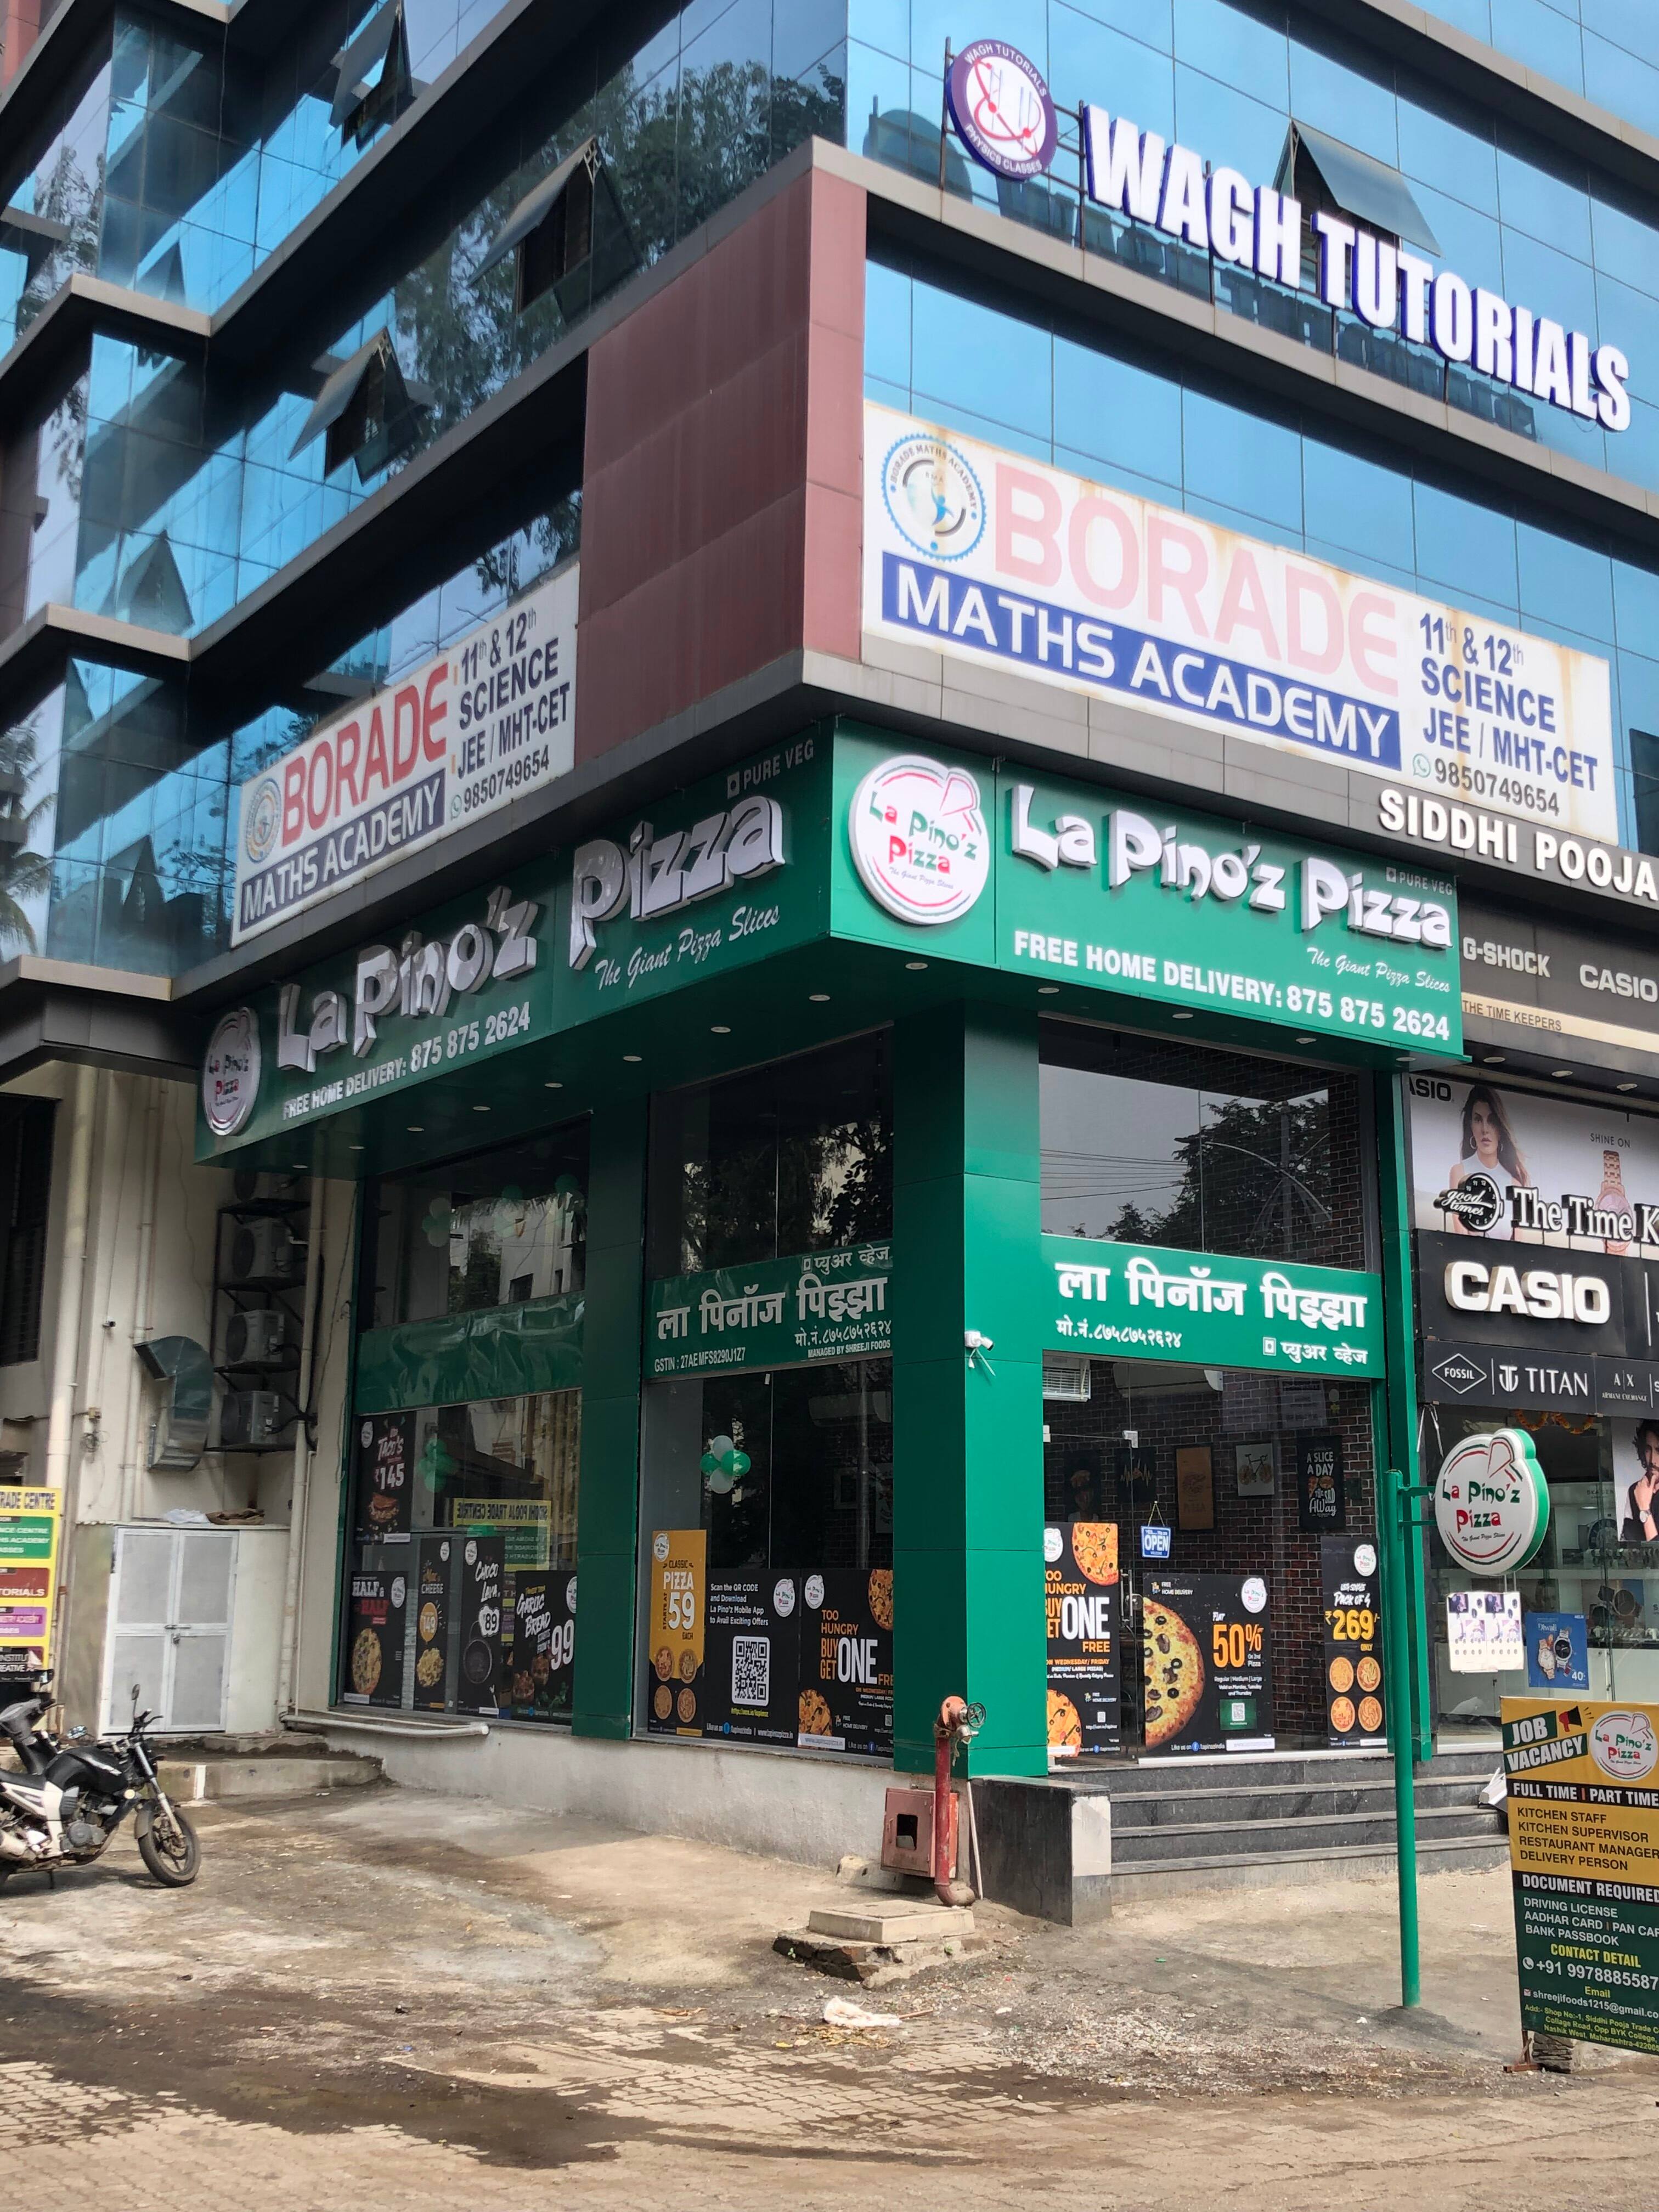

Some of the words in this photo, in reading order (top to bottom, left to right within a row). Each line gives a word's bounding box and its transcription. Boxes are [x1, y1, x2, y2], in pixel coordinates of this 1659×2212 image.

[964, 44, 993, 64] WAGH
[996, 44, 1047, 97] TUTORIALS
[966, 124, 1001, 165] PHYSICS
[1003, 160, 1042, 173] CLASSES
[1081, 104, 1301, 289] WAGH
[1311, 212, 1630, 432] TUTORIALS
[890, 447, 913, 483] BORADE
[949, 458, 977, 509] ACADEMY
[995, 462, 1398, 697] BORADE
[460, 639, 488, 685] 11th
[491, 630, 502, 664] &
[506, 608, 537, 659] 12th
[898, 563, 1115, 679] MATHS
[1130, 641, 1390, 759] ACADEMY
[1420, 613, 1457, 654] 11th
[1463, 627, 1479, 666] &
[1484, 635, 1524, 677] 12th
[459, 637, 559, 730] SCIENCE
[1421, 657, 1556, 733] SCIENCE
[457, 730, 486, 780] JEE
[498, 682, 570, 757] MHT-CET
[1423, 707, 1471, 754] JEE
[1492, 726, 1598, 792] MHT-CET
[281, 662, 449, 848] BORADE
[743, 754, 780, 790] PURE
[785, 738, 814, 769] VEG
[464, 744, 550, 813] 9850749654
[1434, 758, 1560, 816] 9850749654
[869, 791, 898, 825] La
[909, 809, 978, 861] Pino'z
[244, 854, 319, 924] MATHS
[323, 777, 442, 880] ACADEMY
[888, 835, 950, 874] Pizza
[1379, 788, 1518, 864] SIDDHI
[1536, 832, 1659, 903] POOJA
[1012, 784, 1098, 871] La
[1108, 809, 1286, 913] Pino'z
[1301, 857, 1453, 950] Pizza
[1400, 872, 1429, 891] PURE
[1431, 878, 1453, 896] VEG
[278, 983, 348, 1073] La
[353, 885, 539, 1058] Pino'z
[569, 795, 786, 970] Pizza
[595, 959, 621, 990] The
[627, 942, 673, 989] Giant
[677, 928, 723, 964] Pizza
[729, 905, 781, 942] Slices
[1014, 930, 1079, 967] FREE
[1086, 945, 1157, 983] HOME
[1163, 959, 1282, 1007] DELIVERY:
[1286, 985, 1333, 1019] 875
[1340, 997, 1385, 1029] 875
[1393, 1007, 1450, 1041] 2624
[1307, 947, 1331, 969] The
[1335, 955, 1370, 978] Giant
[1375, 962, 1410, 988] Pizza
[1415, 970, 1451, 994] Slices
[1463, 936, 1551, 978] G-SHOCK
[1579, 964, 1658, 1003] CASIO
[1462, 1000, 1484, 1015] THE
[1486, 1005, 1511, 1021] TIME
[1514, 1011, 1562, 1031] KEEPERS
[283, 1094, 309, 1120] FREE
[311, 1081, 343, 1109] HOME
[346, 1057, 407, 1098] DELIVERY:
[410, 1038, 442, 1073] 875
[446, 1020, 479, 1059] 875
[484, 1001, 531, 1044] 2624
[1590, 1132, 1615, 1146] SHINE
[1618, 1137, 1631, 1148] ON
[1513, 1187, 1562, 1232] The
[1569, 1195, 1633, 1242] Time
[1054, 1262, 1110, 1301] ला
[1124, 1256, 1247, 1316] पिनॉज
[1444, 1261, 1611, 1324] CASIO
[656, 1306, 691, 1340] ला
[698, 1283, 786, 1335] पिनॉज
[654, 1355, 675, 1373] GSTIN
[808, 1346, 836, 1359] MANAGED
[837, 1345, 845, 1356] BY
[845, 1342, 870, 1355] SHREEJI
[871, 1339, 891, 1351] FOODS
[1444, 1366, 1475, 1380] FOSSIL
[1525, 1367, 1589, 1397] TITAN
[1313, 1451, 1334, 1463] SLICE
[1316, 1463, 1334, 1476] DAY
[1442, 1479, 1460, 1502] La
[1468, 1481, 1520, 1504] Pino'z
[1456, 1509, 1502, 1533] Pizza
[1144, 1534, 1169, 1551] OPEN
[352, 1581, 380, 1597] HALF
[421, 1583, 444, 1594] CHEESE
[663, 1571, 694, 1590] PIZZA
[668, 1592, 695, 1629] 59
[753, 1606, 764, 1615] App
[821, 1610, 839, 1621] TOO
[821, 1622, 859, 1635] HUNGRY
[1062, 1596, 1110, 1640] ONE
[551, 1620, 575, 1671] 99
[821, 1638, 839, 1658] BUY
[838, 1637, 878, 1684] ONE
[1082, 1641, 1110, 1653] FREE
[1213, 1623, 1261, 1668] 50%
[820, 1658, 837, 1680] GET
[1512, 1716, 1548, 1746] JOB
[1595, 1729, 1610, 1743] La
[1615, 1734, 1652, 1752] Pino'z
[1506, 1735, 1584, 1772] VACANCY
[1607, 1746, 1641, 1760] Pizza
[1513, 1782, 1543, 1797] FULL
[1546, 1785, 1577, 1800] TIME
[1590, 1788, 1622, 1804] PART
[1626, 1791, 1659, 1807] TIME
[1517, 1807, 1567, 1820] KITCHEN
[1571, 1812, 1607, 1824] STAFF
[1518, 1821, 1568, 1835] KITCHEN
[1572, 1826, 1649, 1843] SUPERVISOR
[1519, 1836, 1595, 1853] RESTAURANT
[1599, 1843, 1659, 1860] MANAGER
[1520, 1850, 1575, 1865] DELIVERY
[1578, 1857, 1628, 1871] PERSON
[1522, 1874, 1592, 1895] DOCUMENT
[1596, 1882, 1659, 1903] REQUIRED
[1523, 1897, 1567, 1912] DRIVING
[1571, 1903, 1618, 1918] LICENSE
[1524, 1911, 1569, 1925] AADHAR
[1571, 1917, 1603, 1930] CARD
[1612, 1921, 1635, 1934] PAN
[1525, 1925, 1555, 1937] BANK
[1558, 1929, 1619, 1946] PASSBOOK
[1550, 1943, 1600, 1961] CONTACT
[1603, 1953, 1641, 1968] DETAIL
[1536, 1959, 1562, 1976] +91
[1567, 1963, 1659, 1991] 9978885587
[1585, 1986, 1610, 1999] Email
[1544, 2007, 1562, 2017] Shop
[1585, 2015, 1608, 2025] Siddhi
[1610, 2019, 1629, 2029] Pooja
[1631, 2023, 1651, 2033] Trade
